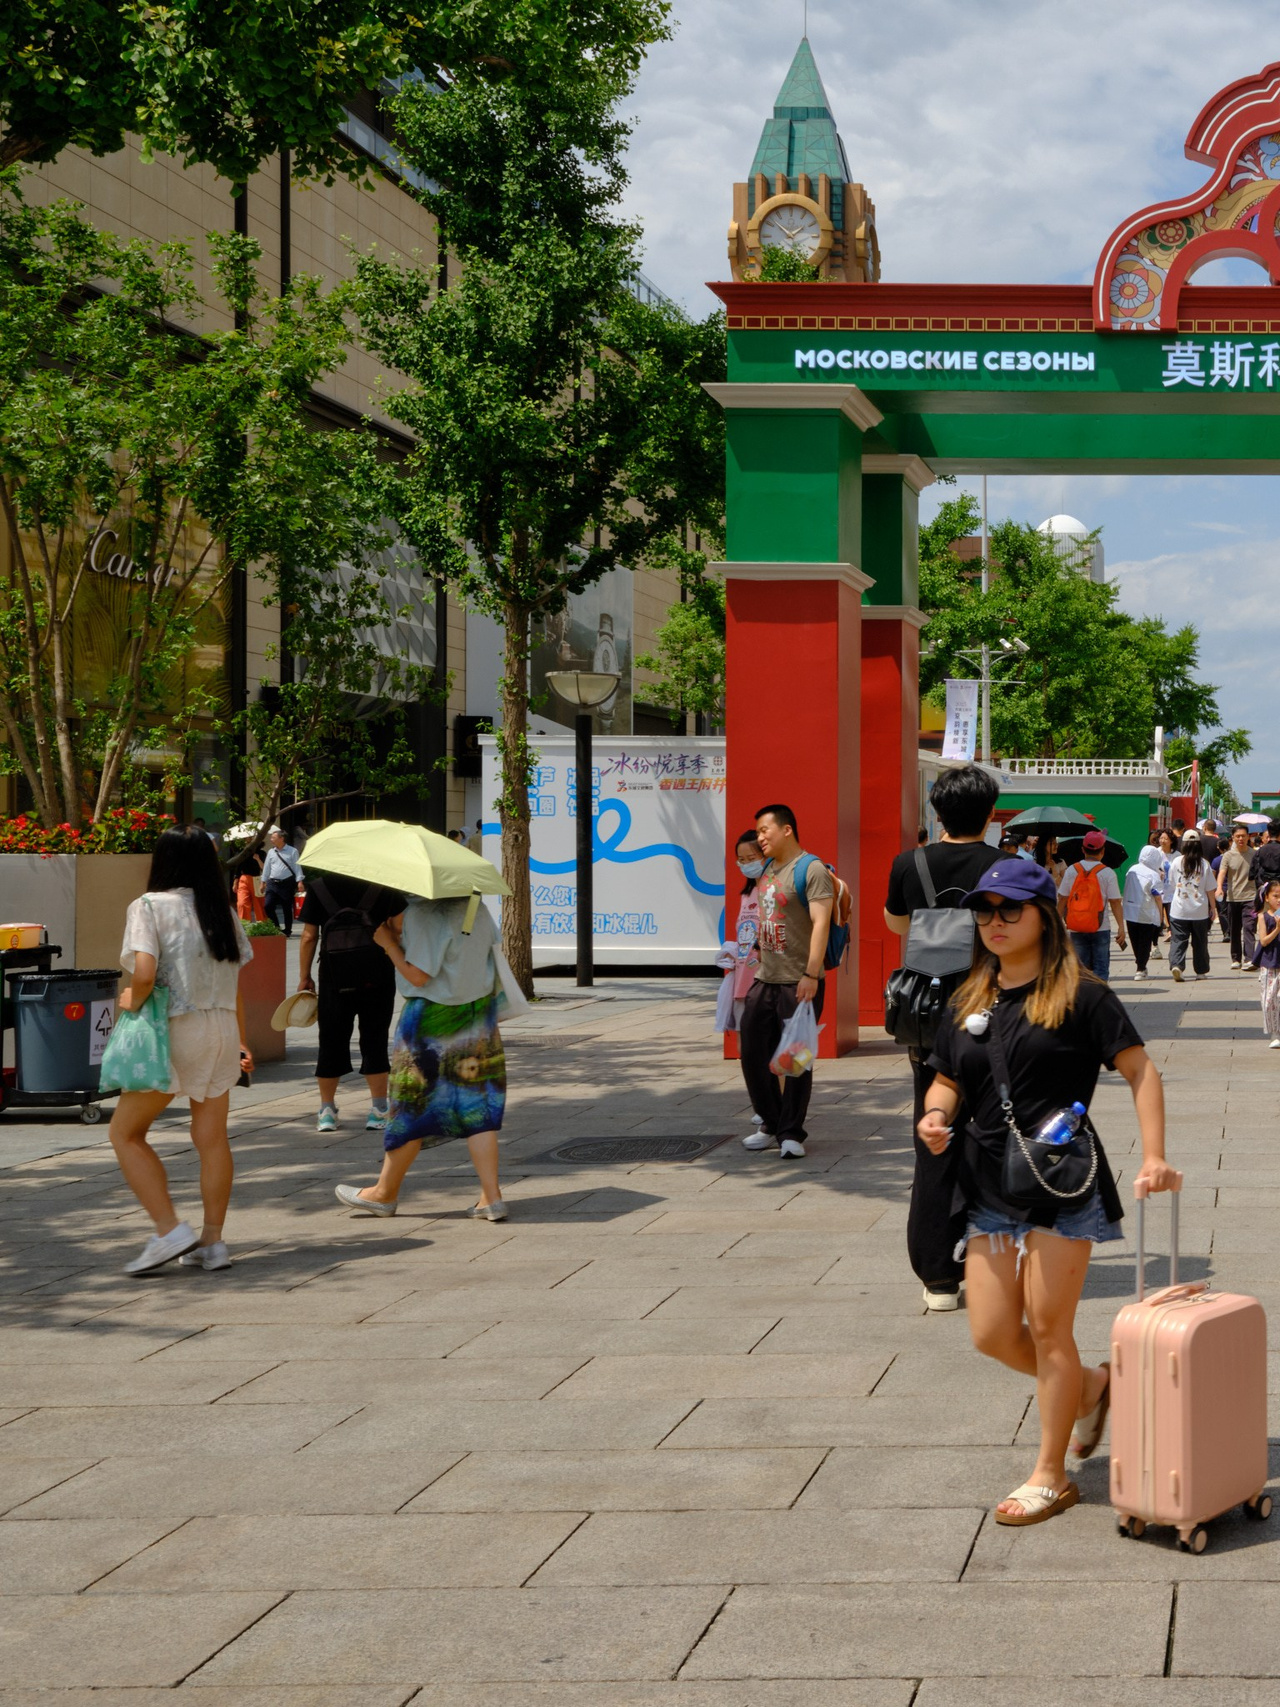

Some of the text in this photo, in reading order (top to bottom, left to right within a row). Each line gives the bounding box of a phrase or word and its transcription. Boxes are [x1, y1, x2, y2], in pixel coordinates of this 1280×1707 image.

[795, 349, 1096, 371] МОСКОВСКИЕ СЕЗОНЫ
[70, 1004, 78, 1018] 7
